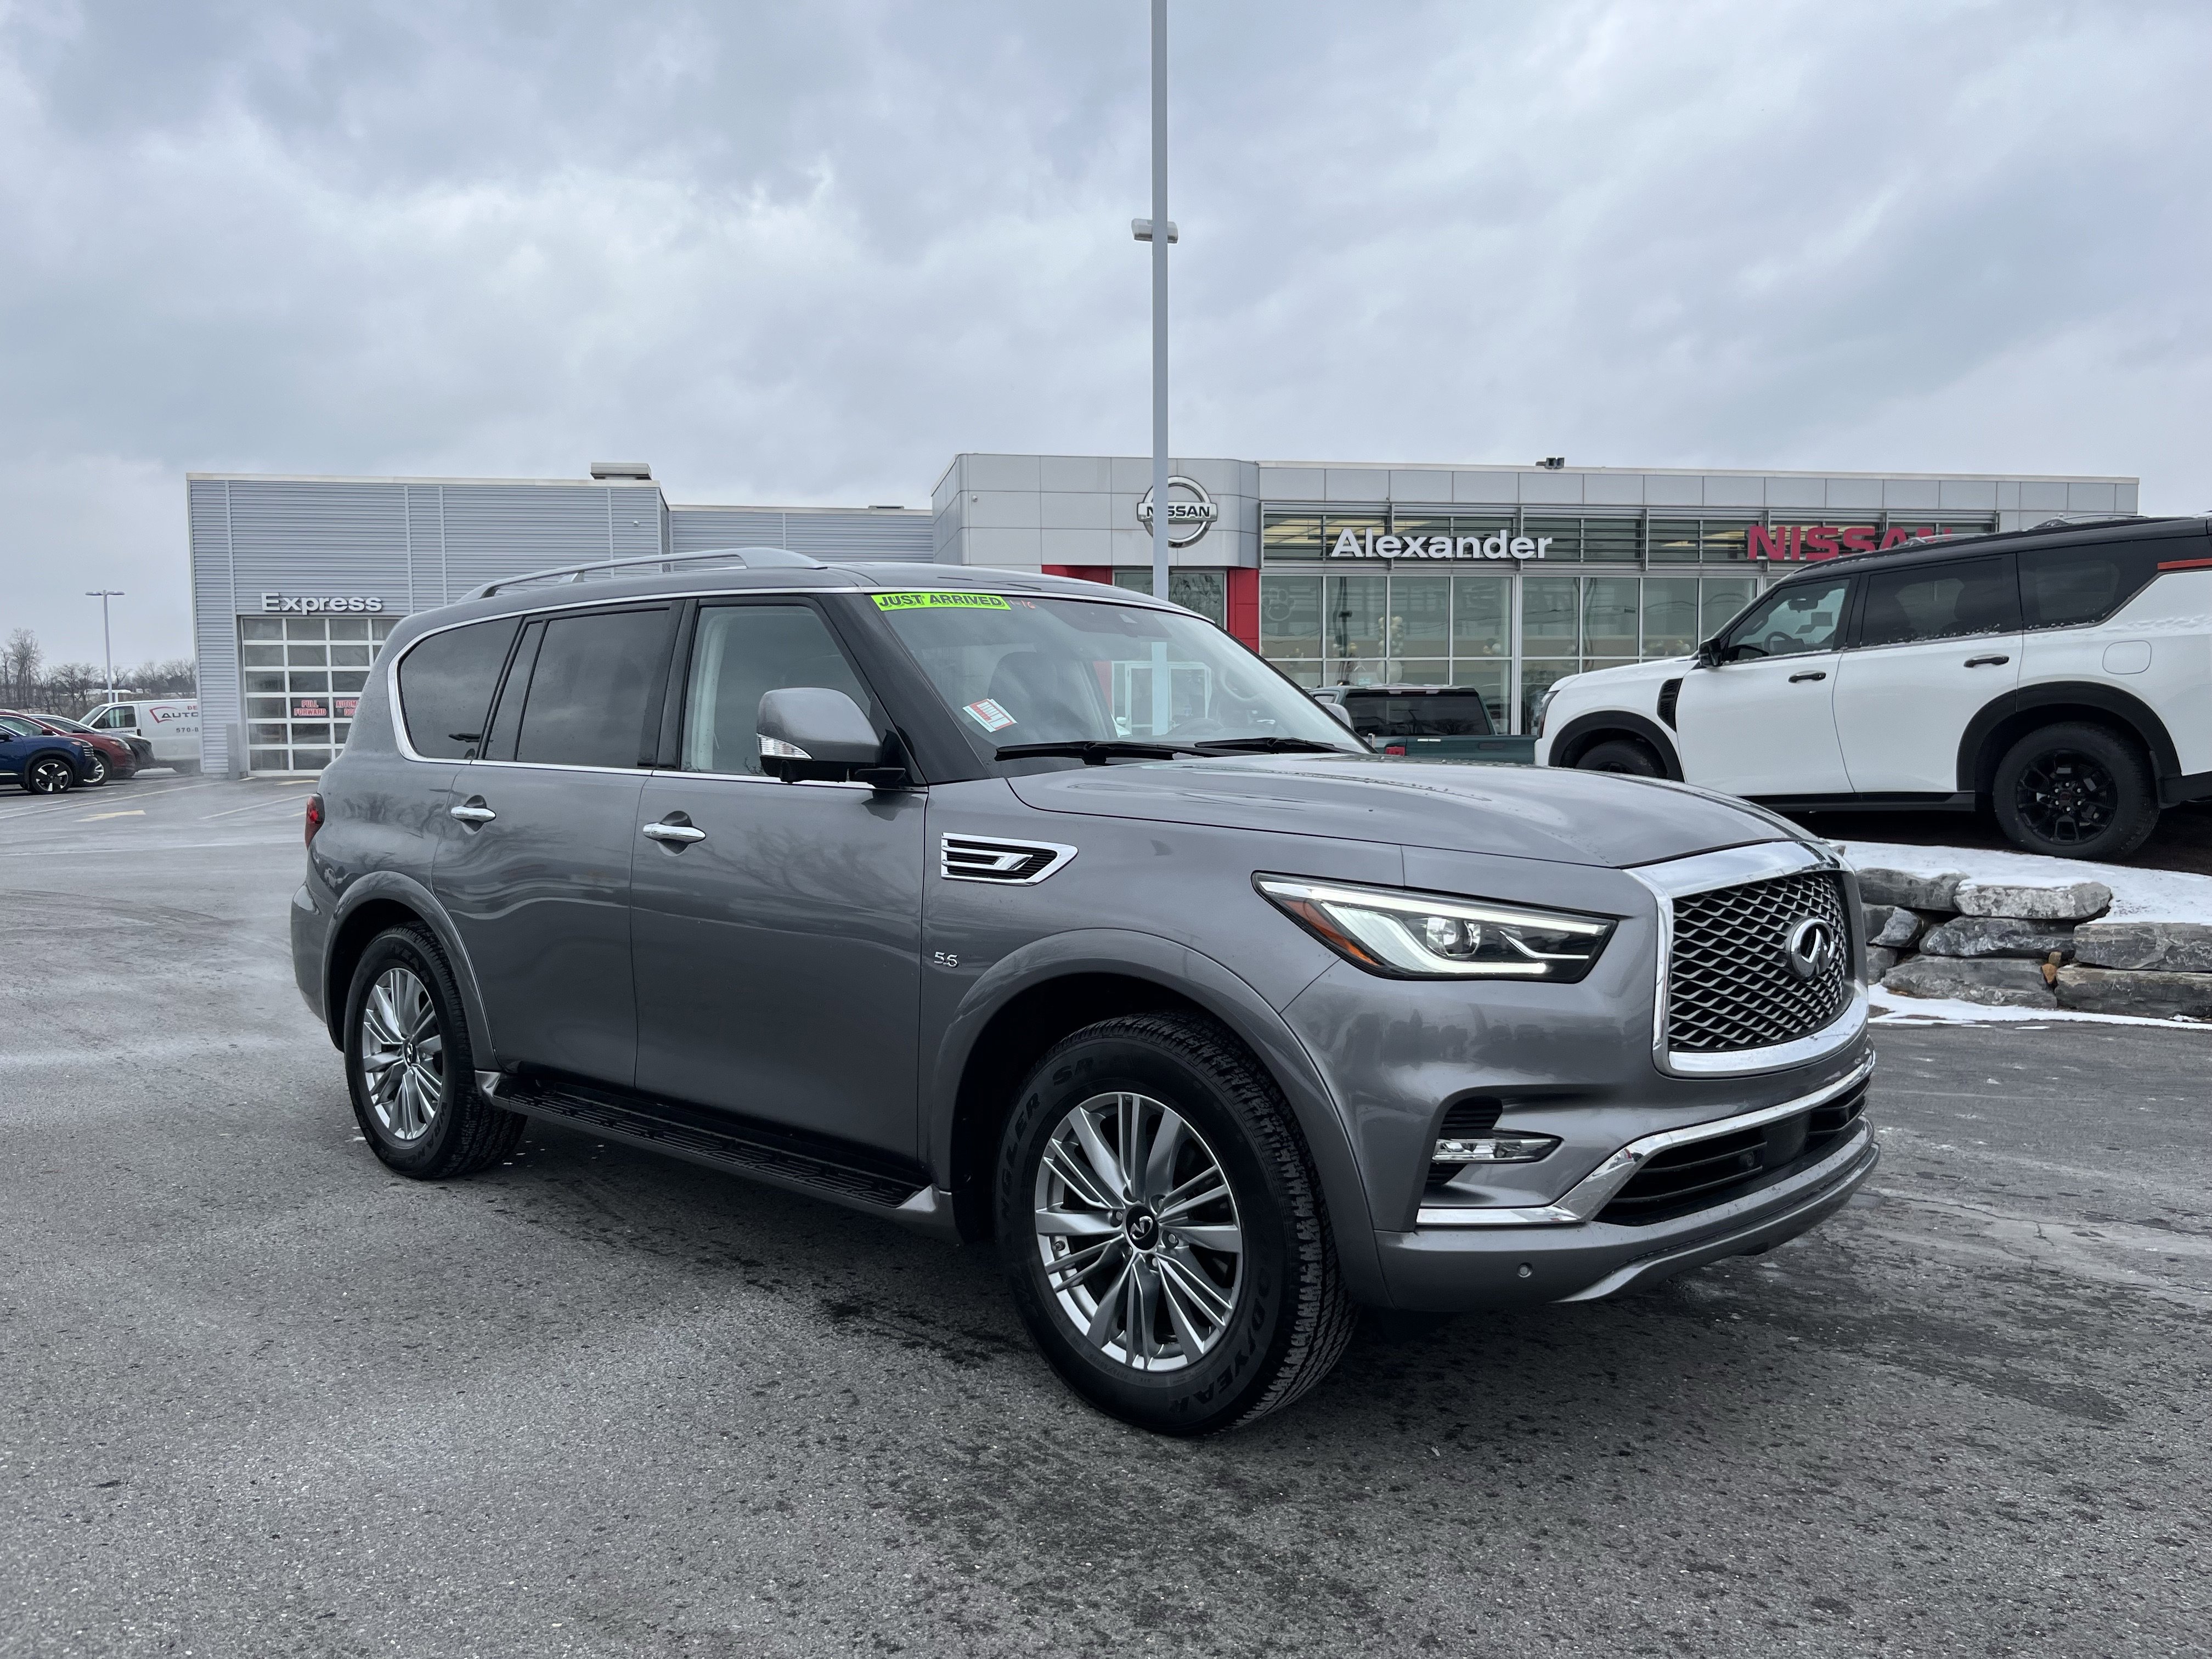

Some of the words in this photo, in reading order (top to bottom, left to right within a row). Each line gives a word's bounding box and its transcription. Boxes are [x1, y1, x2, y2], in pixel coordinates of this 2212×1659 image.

[1147, 505, 1210, 517] NSSAN
[1330, 528, 1553, 559] Alexander
[261, 592, 383, 616] Express
[879, 595, 925, 608] JUST
[929, 594, 1005, 607] ARRIVED
[301, 699, 319, 708] PULL
[294, 708, 326, 716] FORWARD
